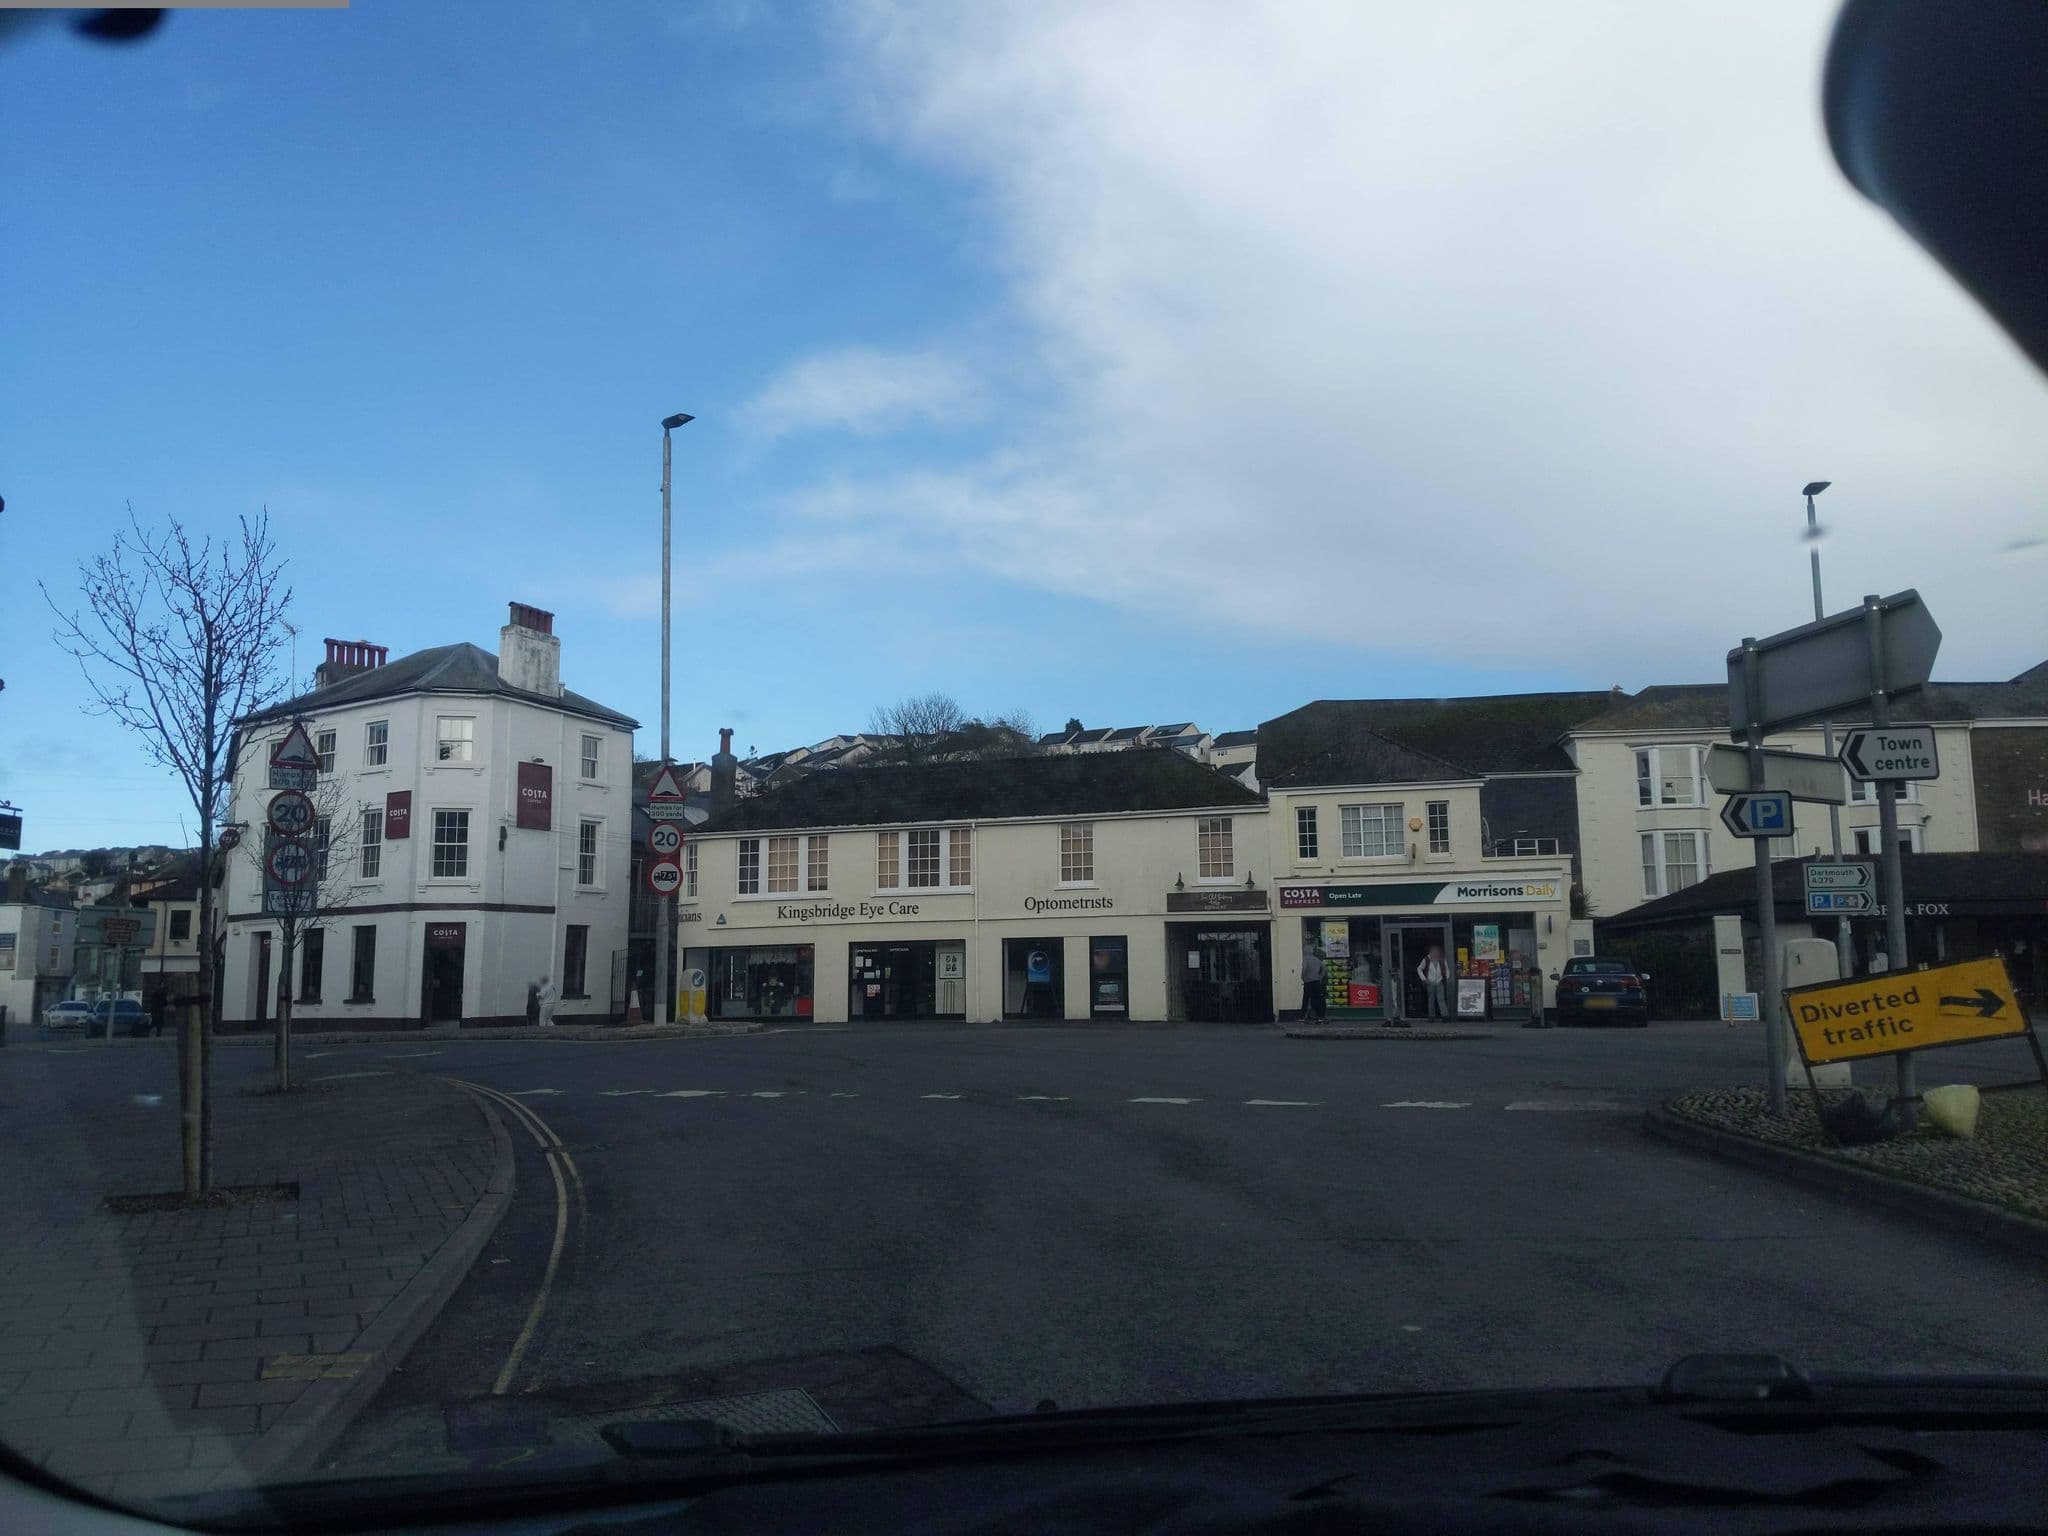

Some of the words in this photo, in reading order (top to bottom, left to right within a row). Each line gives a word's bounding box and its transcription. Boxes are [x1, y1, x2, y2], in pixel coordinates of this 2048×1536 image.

[1876, 736, 1922, 751] Town
[1874, 755, 1930, 770] centre
[521, 788, 547, 799] COSTA
[275, 804, 308, 821] 20
[389, 808, 408, 817] COSTA
[1757, 800, 1777, 828] P
[654, 831, 678, 847] 20
[1284, 889, 1320, 899] COSTA
[1328, 892, 1347, 900] Open
[1457, 884, 1524, 897] Morrisons
[1526, 882, 1556, 898] Daily
[777, 903, 855, 921] Kingsbridge
[859, 902, 885, 919] Eye
[889, 901, 919, 915] Care
[1024, 896, 1114, 914] Optometrists
[1904, 906, 1913, 915] &
[1917, 903, 1949, 915] FOX
[433, 929, 458, 937] COSTA
[1800, 986, 1920, 1023] Diverted
[1823, 1016, 1914, 1045] traffic
